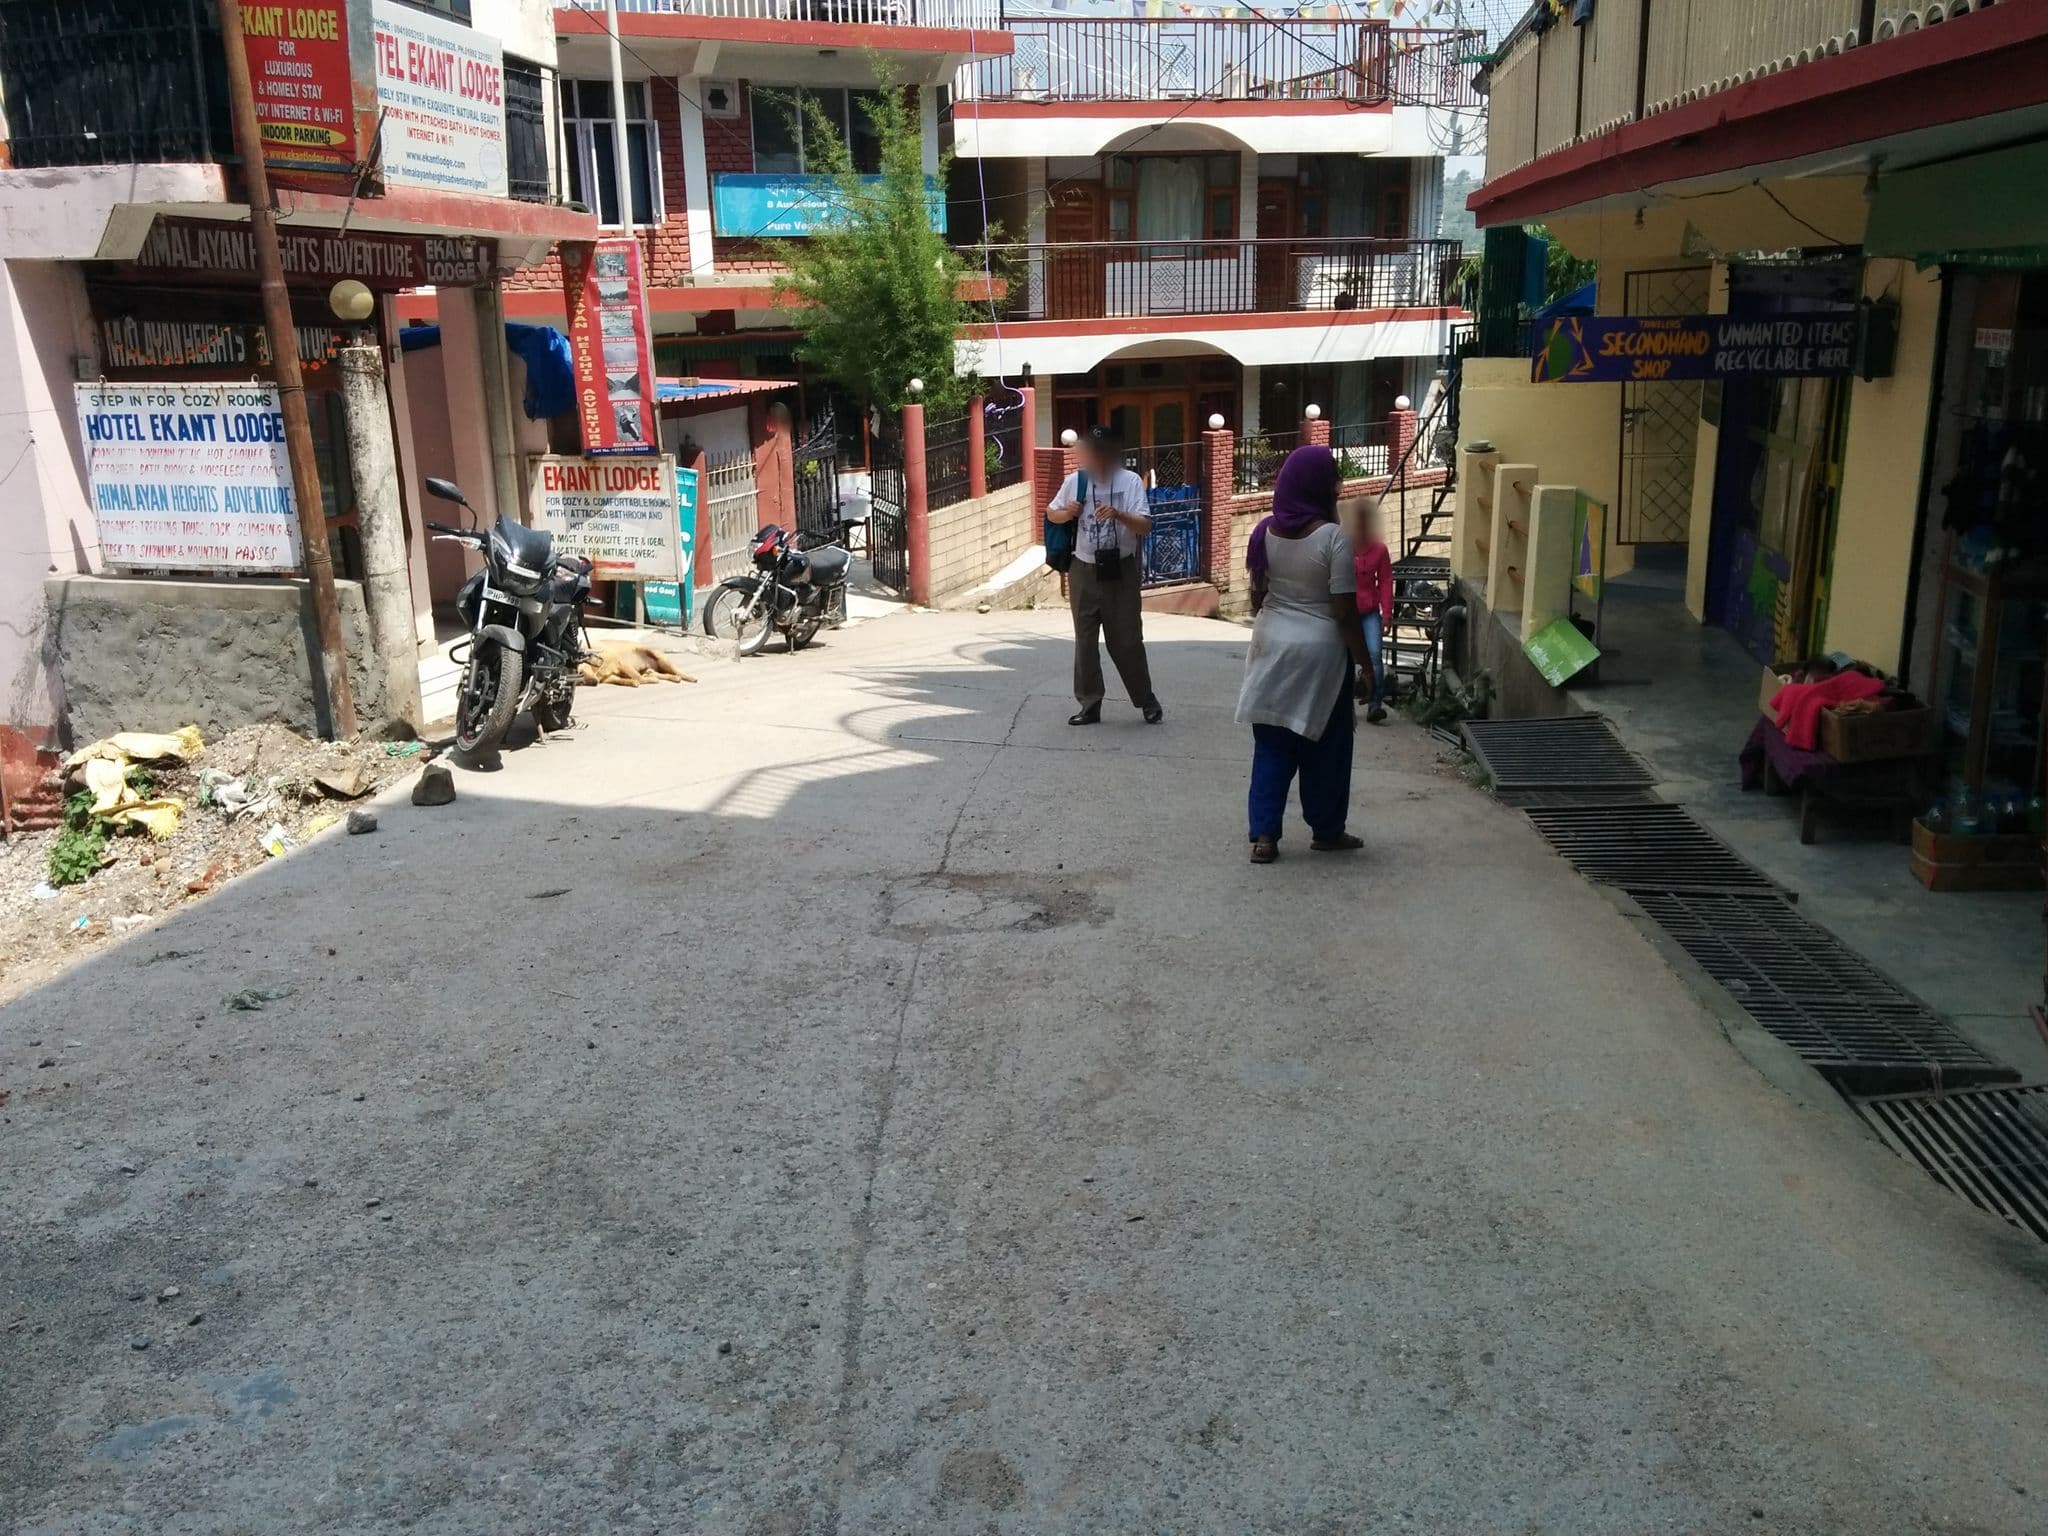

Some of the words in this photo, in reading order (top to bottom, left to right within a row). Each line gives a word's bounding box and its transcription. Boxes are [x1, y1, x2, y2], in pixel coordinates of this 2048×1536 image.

[240, 6, 283, 36] KANT
[287, 8, 338, 40] LODGE
[279, 41, 296, 56] FOR
[265, 60, 313, 78] LUXURIOUS
[408, 41, 454, 94] EKANT
[458, 57, 501, 107] LODGE
[258, 80, 265, 95] &
[266, 81, 299, 97] HOMELY
[302, 83, 322, 99] STAY
[271, 104, 311, 121] INTERNET
[314, 107, 321, 121] &
[395, 91, 411, 103] STAY
[411, 95, 427, 107] WITH
[427, 99, 455, 115] EXQUISITE
[456, 106, 479, 121] NATURAL
[404, 109, 418, 121] WITH
[420, 113, 448, 129] ATTACHED
[449, 119, 462, 132] BATH
[469, 125, 479, 137] HOT
[261, 125, 292, 141] INDOOR
[294, 128, 331, 144] PARKING
[406, 127, 435, 142] INTERNET
[406, 151, 465, 168] www.ekantlodge.com
[767, 220, 791, 230] Pure
[248, 231, 321, 273] HGHTS
[324, 239, 414, 278] ADVENTURE
[426, 261, 477, 281] LODGE
[1718, 321, 1803, 347] UNWANTED
[1808, 321, 1854, 345] ITEMS
[1599, 331, 1710, 357] SECONDHAND
[576, 335, 594, 382] HEIGHTS
[1714, 348, 1815, 372] RECYCLABLE
[1816, 347, 1849, 367] HERE
[1632, 359, 1671, 378] SHOP
[90, 395, 124, 407] STEP
[129, 395, 142, 407] IN
[147, 395, 175, 407] FOR
[183, 395, 220, 407] COZY
[227, 394, 272, 407] ROOMS
[582, 388, 602, 447] ADVENTURE
[86, 413, 146, 441] HOTEL
[149, 413, 216, 442] EKANT
[222, 413, 286, 443] LODGE
[543, 465, 601, 492] EKANT
[604, 466, 661, 492] LODGE
[96, 483, 170, 512] HIMALAYAN
[171, 485, 219, 513] HEIGHTS
[224, 486, 293, 515] ADVENTURE
[546, 497, 560, 507] FOR
[562, 497, 582, 507] COZY
[584, 497, 591, 506] &
[593, 497, 648, 508] COMFORTABLE
[546, 509, 566, 519] WITH
[570, 508, 608, 519] ATTACHED
[609, 509, 647, 520] BATHROOM
[649, 510, 663, 520] AND
[570, 522, 585, 532] HOT
[647, 537, 666, 547] IDEAL
[235, 546, 277, 561] PASSES
[602, 548, 628, 557] NATURE
